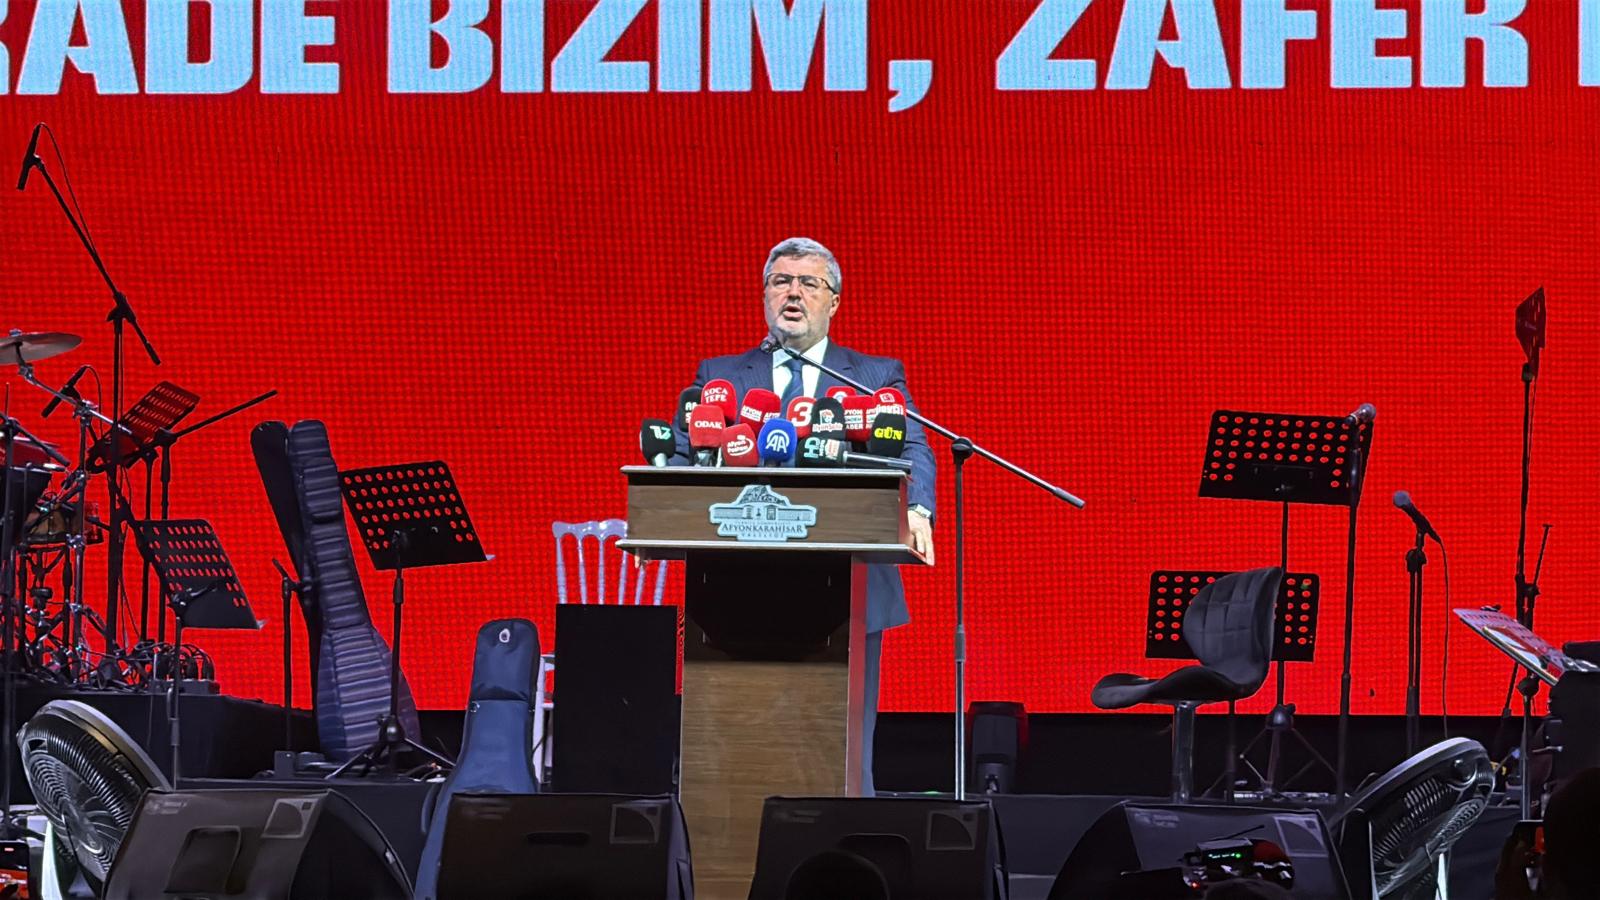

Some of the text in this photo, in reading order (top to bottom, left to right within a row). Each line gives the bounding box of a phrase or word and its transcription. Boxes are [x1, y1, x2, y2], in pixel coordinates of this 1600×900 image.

[0, 0, 340, 95] ADE
[995, 0, 1529, 91] ZAFER
[704, 387, 728, 397] KOCA
[705, 394, 727, 403] TEPE
[792, 402, 813, 427] 3
[694, 420, 722, 429] ODAK
[874, 426, 902, 440] GÜN
[766, 435, 788, 454] AA
